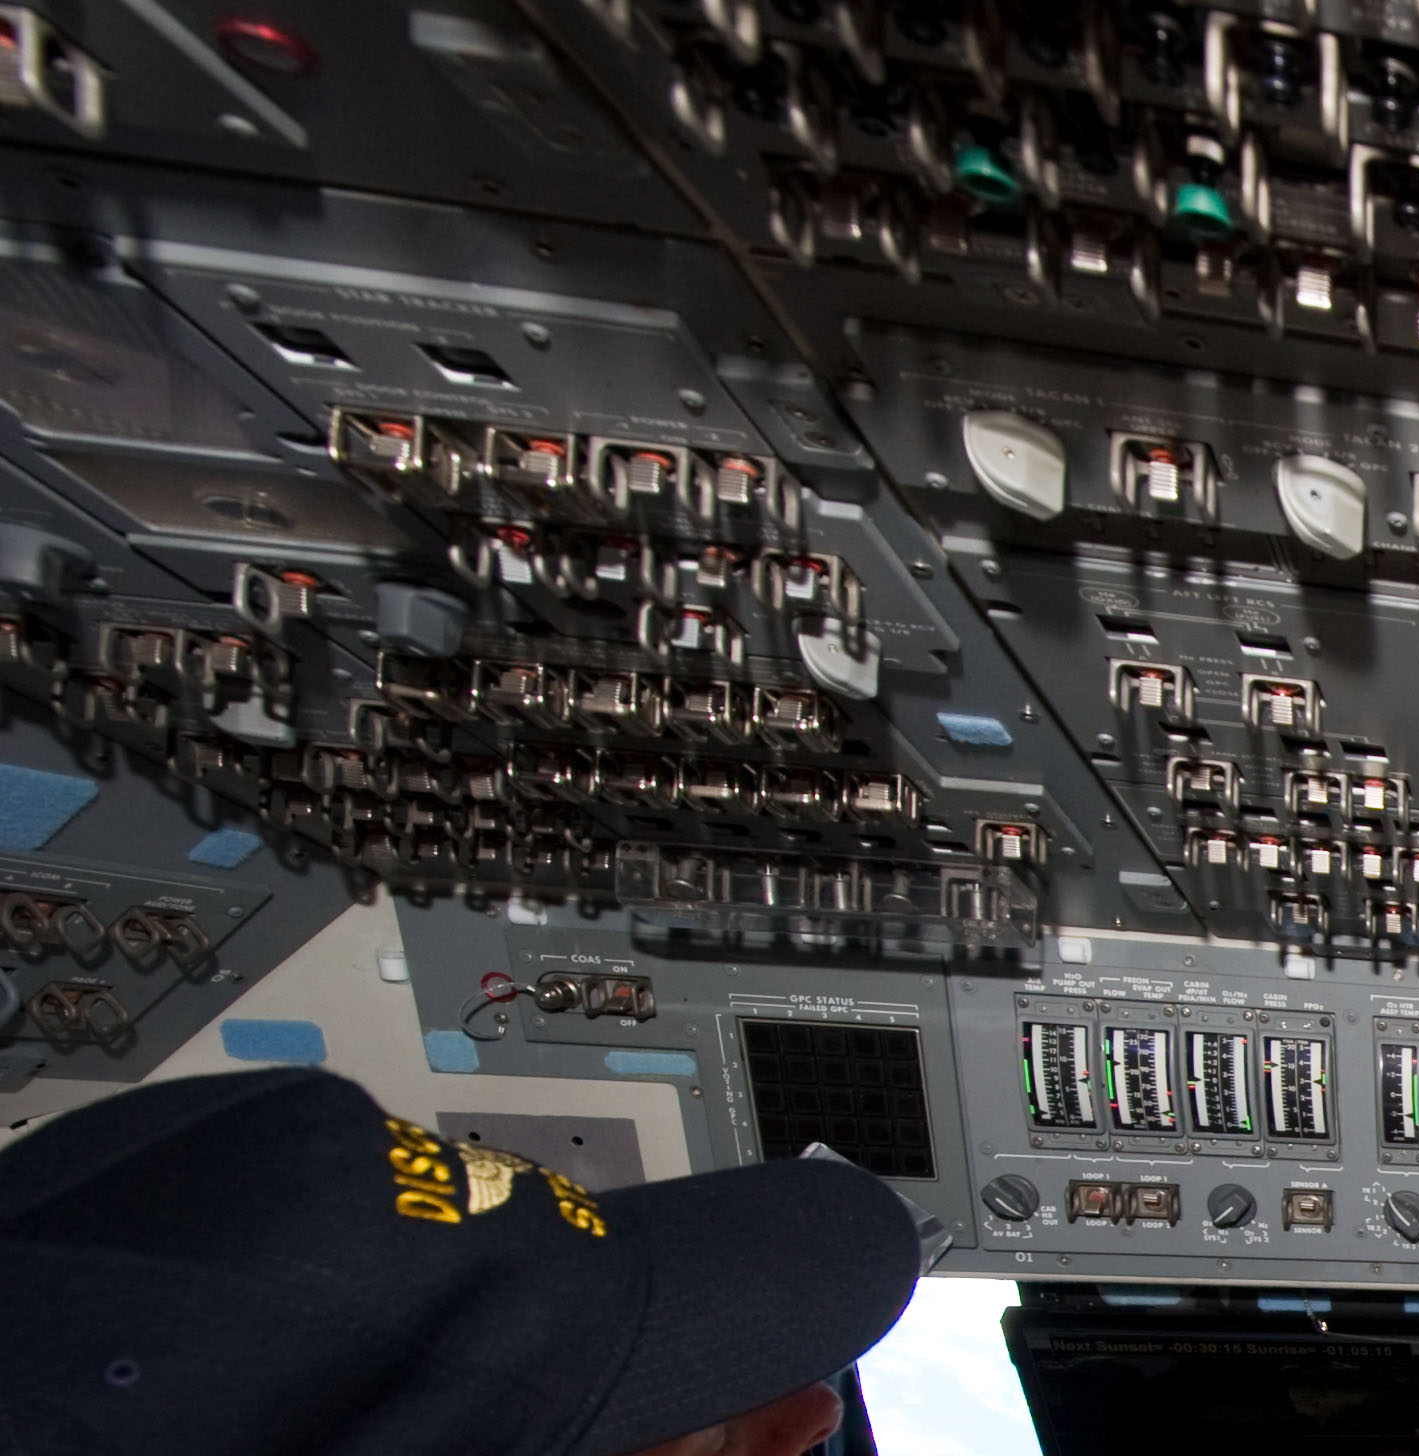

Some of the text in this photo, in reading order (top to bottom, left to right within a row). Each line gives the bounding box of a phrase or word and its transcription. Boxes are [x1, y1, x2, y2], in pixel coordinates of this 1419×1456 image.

[570, 954, 602, 964] COAS
[612, 965, 629, 973] ON
[789, 994, 855, 1006] GPC STATUS
[798, 1004, 849, 1013] FAILED GPC
